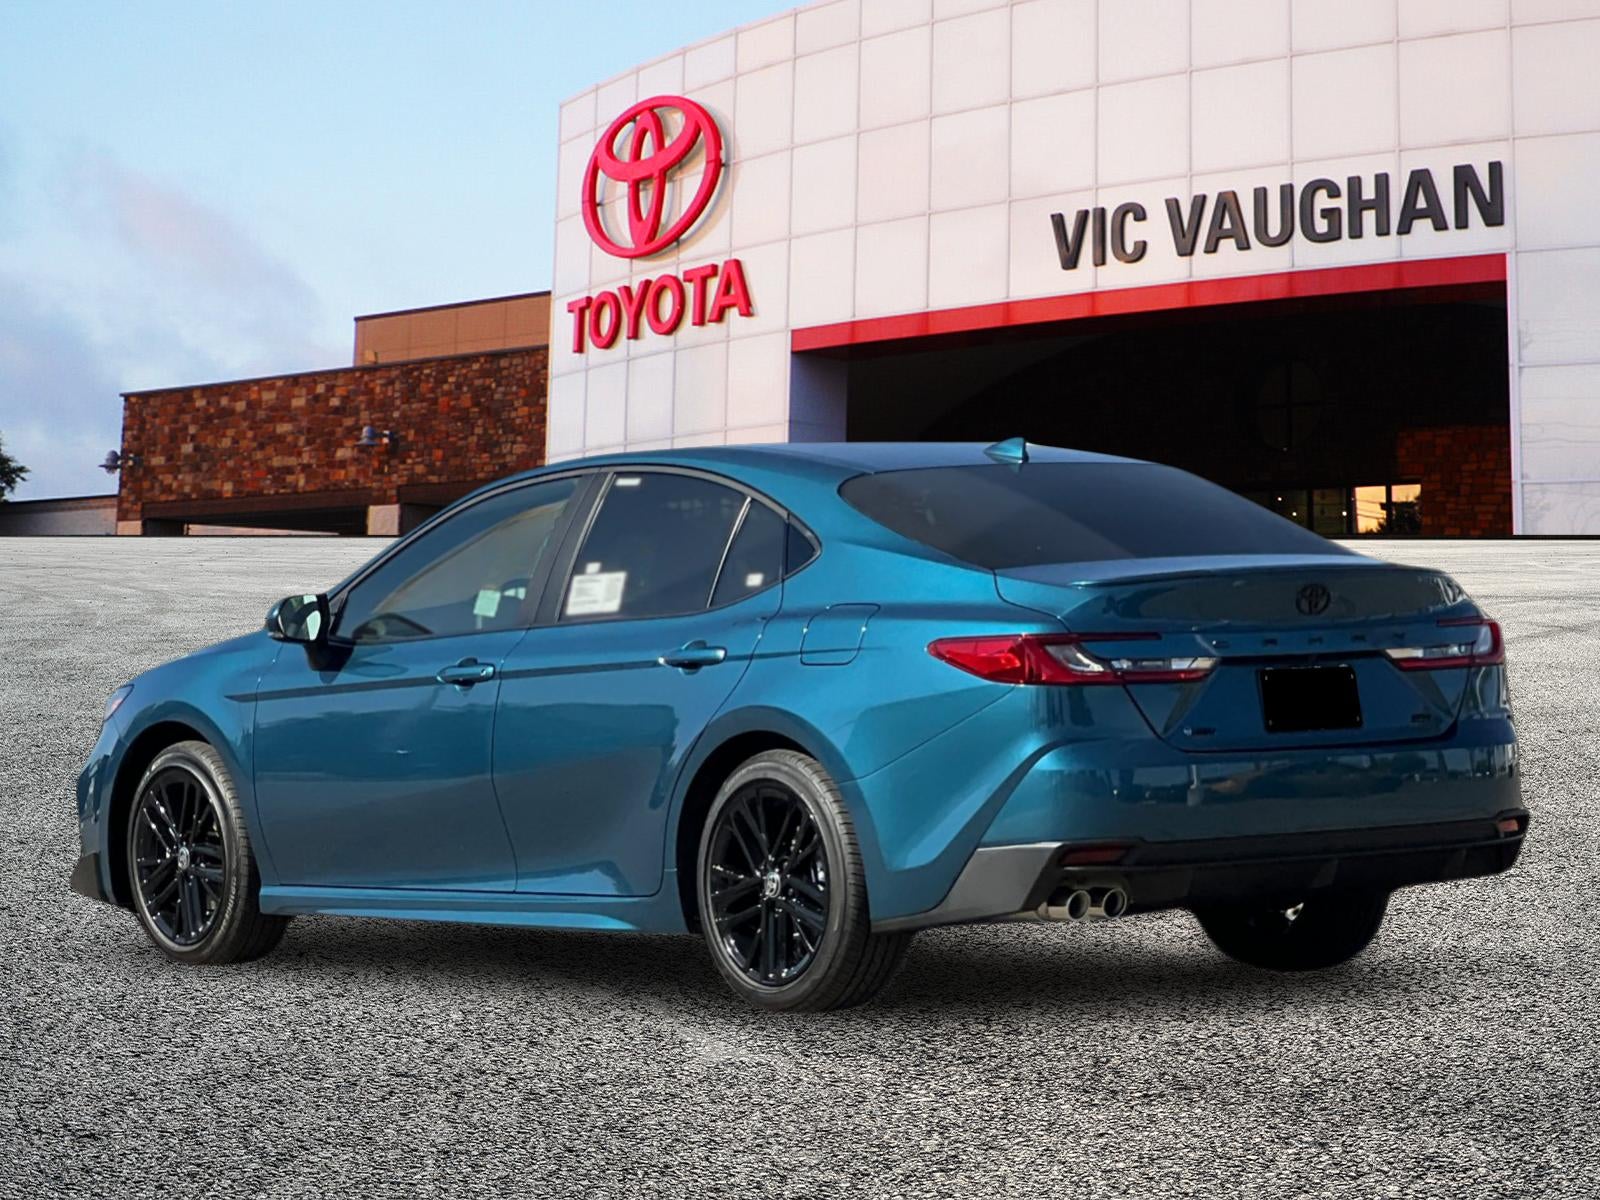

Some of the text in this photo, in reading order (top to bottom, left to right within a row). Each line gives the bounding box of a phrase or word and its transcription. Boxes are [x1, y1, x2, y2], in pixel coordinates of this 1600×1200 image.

[1050, 160, 1505, 271] VIC VAUGHAN
[567, 258, 754, 354] TOYOTA
